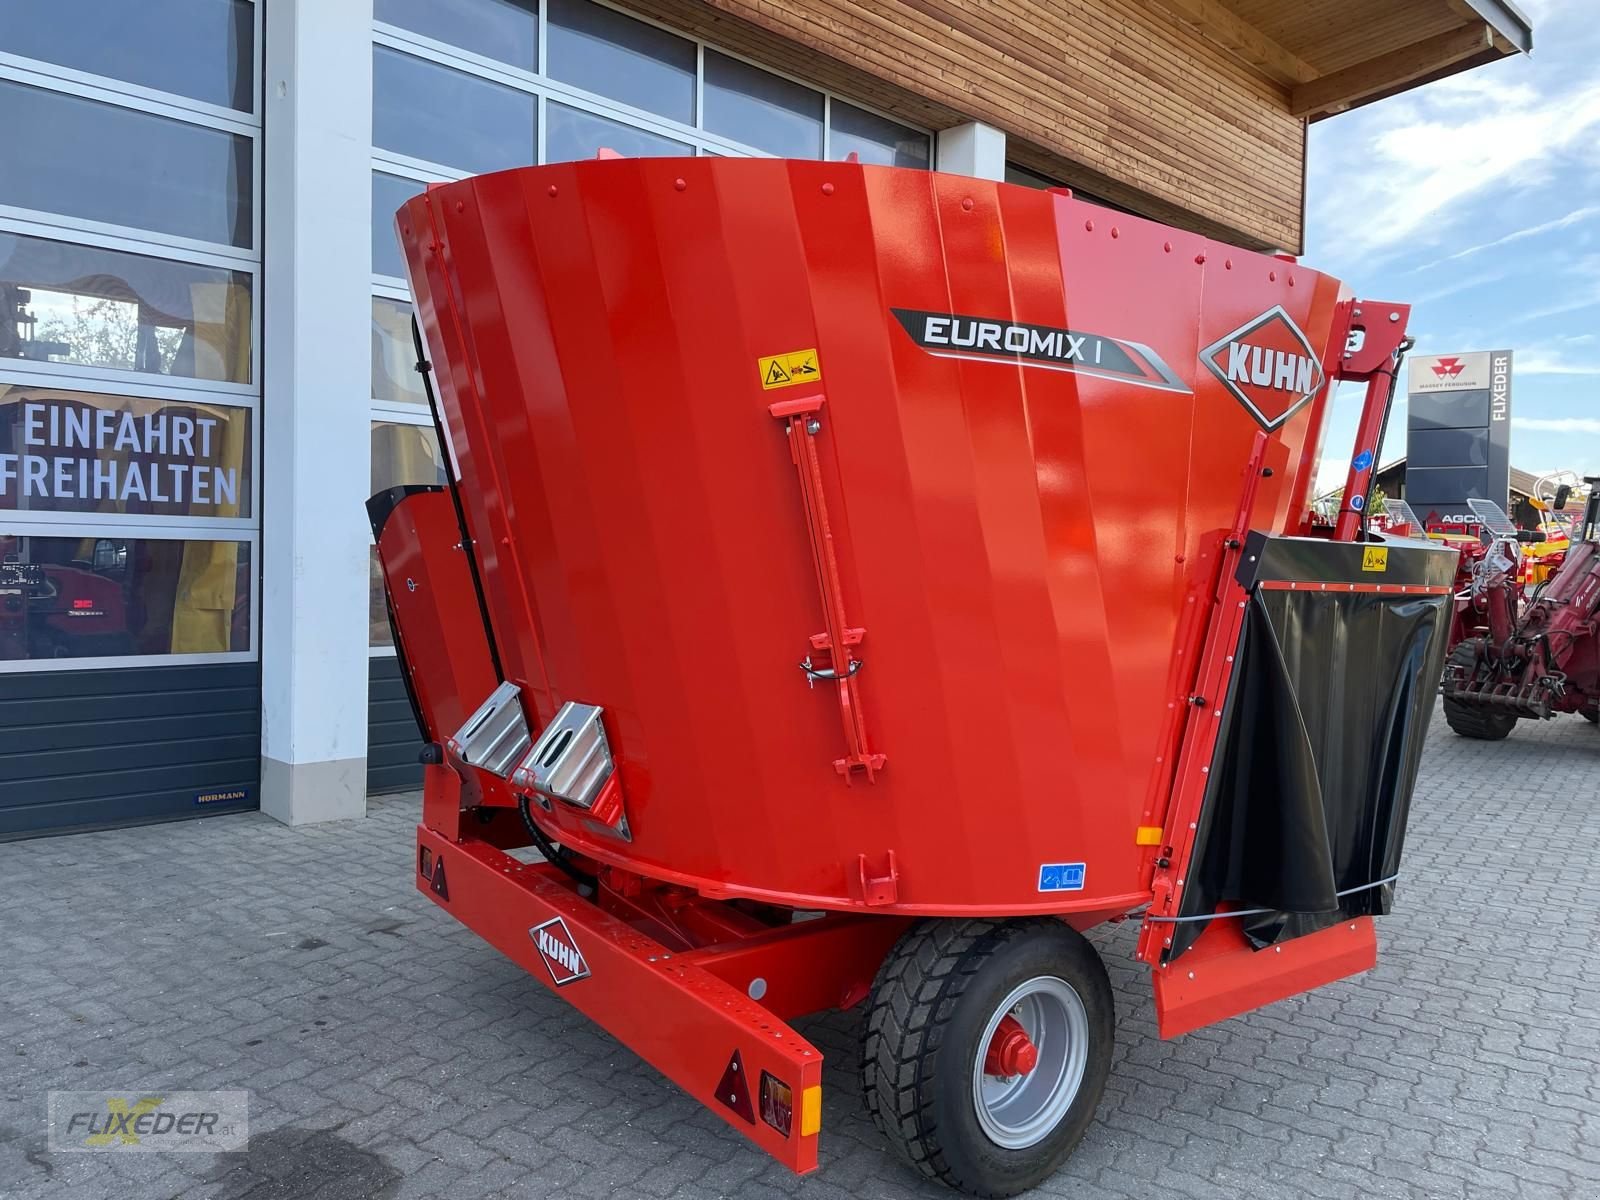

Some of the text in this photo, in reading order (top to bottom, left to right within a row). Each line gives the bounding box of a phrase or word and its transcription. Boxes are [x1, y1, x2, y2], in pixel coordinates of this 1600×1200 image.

[923, 316, 1086, 361] EUROMIX
[1227, 342, 1314, 395] KUHN
[1493, 356, 1508, 421] FLIXEDER
[24, 403, 217, 457] EINFAHRT
[0, 454, 236, 505] FREIHALTEN
[539, 928, 580, 976] KUHN
